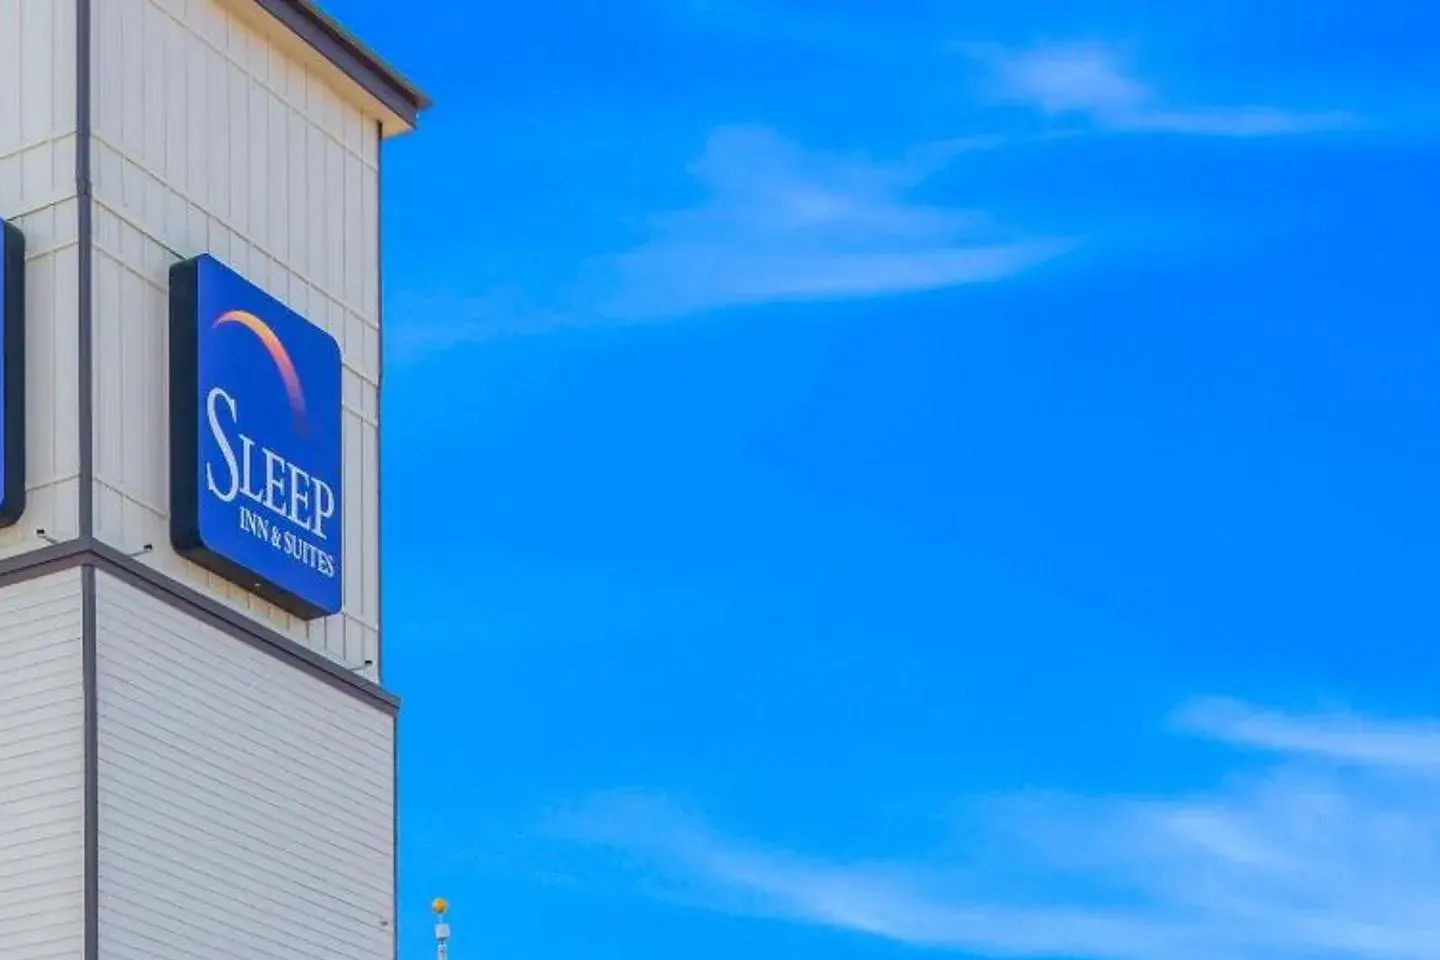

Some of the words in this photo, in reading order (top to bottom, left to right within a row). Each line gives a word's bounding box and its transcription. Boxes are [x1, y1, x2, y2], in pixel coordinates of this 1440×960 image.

[206, 387, 335, 540] SLEEP
[240, 506, 269, 542] INN
[271, 525, 283, 550] &
[284, 532, 336, 577] SUITES
